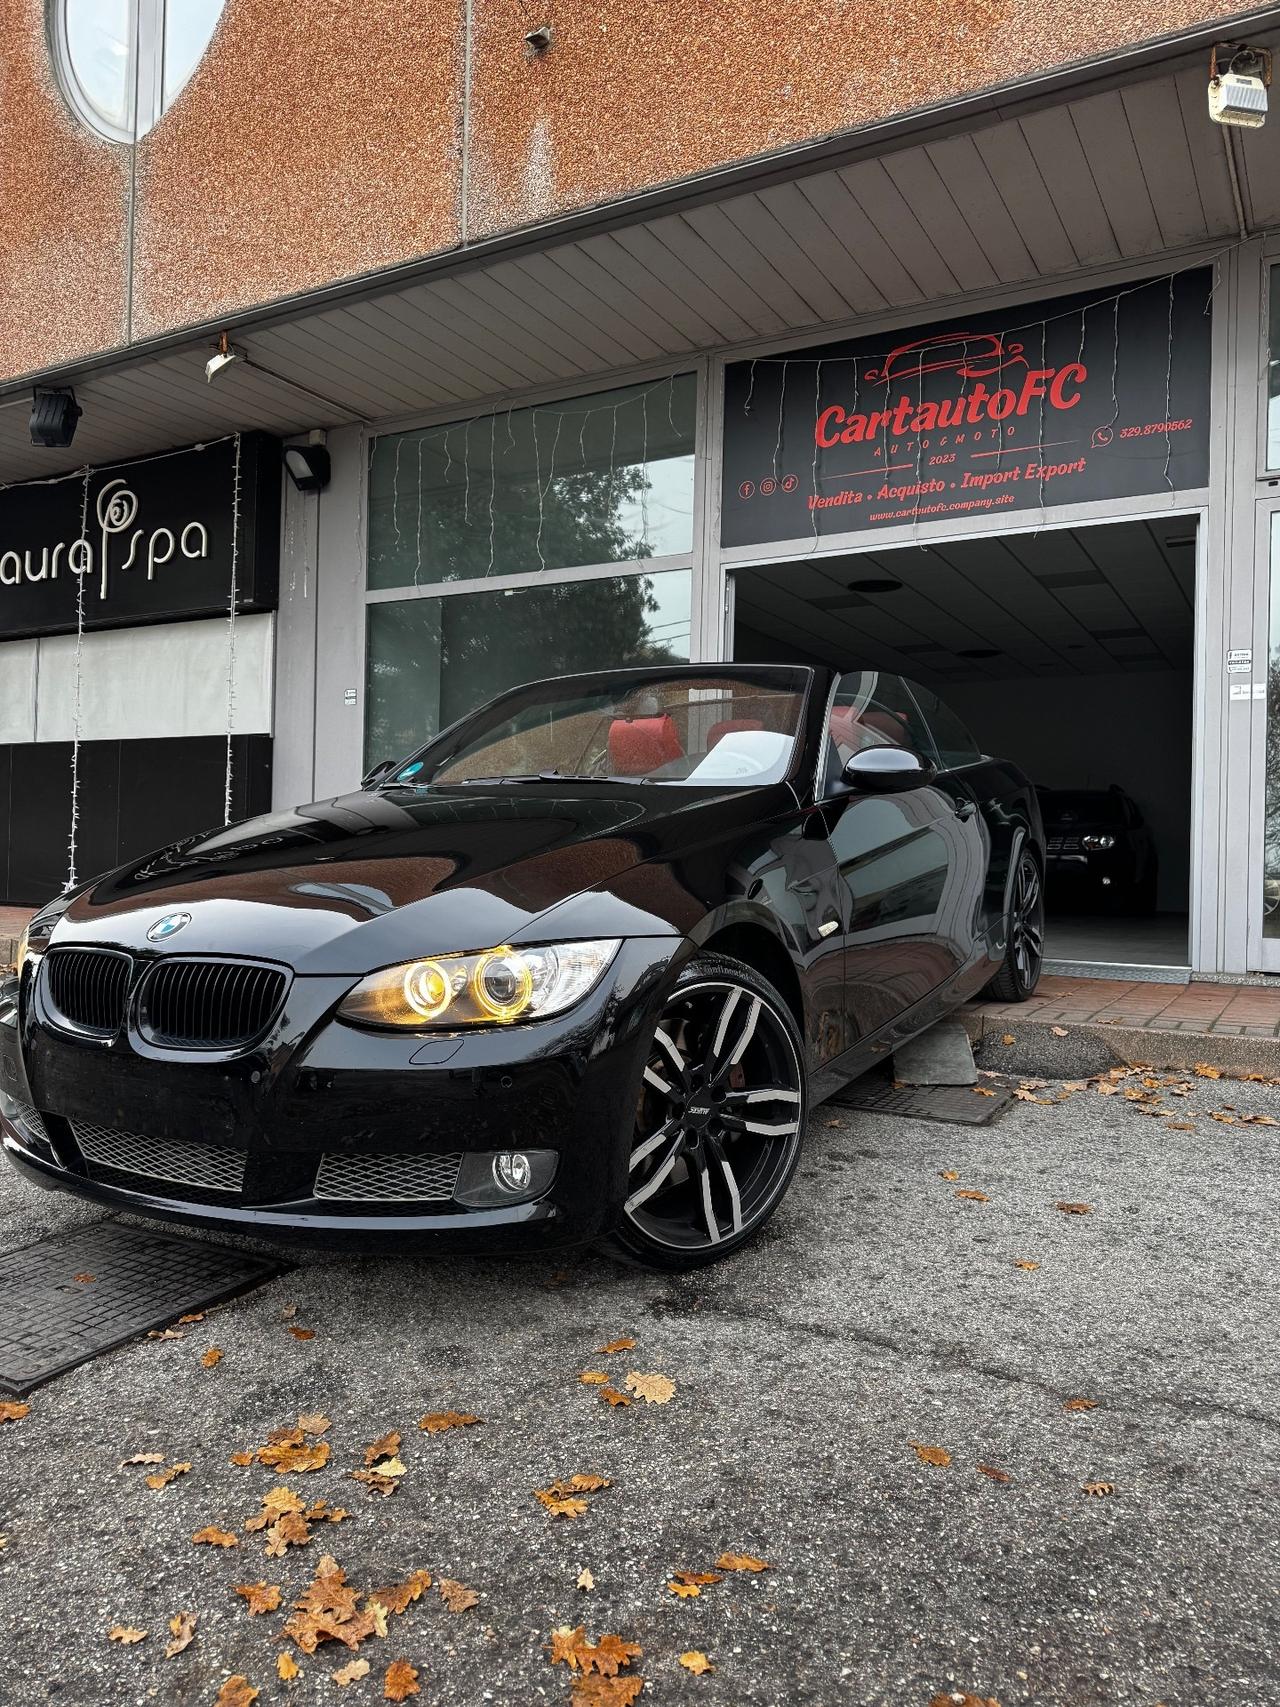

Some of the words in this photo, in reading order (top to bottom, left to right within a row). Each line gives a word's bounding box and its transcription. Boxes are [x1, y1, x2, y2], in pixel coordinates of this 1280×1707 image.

[815, 363, 1087, 448] CartautoFC
[1119, 419, 1193, 439] 329.8790562
[807, 490, 863, 511] Vendita
[876, 478, 946, 501] Acquisto
[960, 466, 1021, 490] Import
[1024, 457, 1087, 481] Export
[928, 453, 956, 466] 2023
[121, 521, 207, 580] spa
